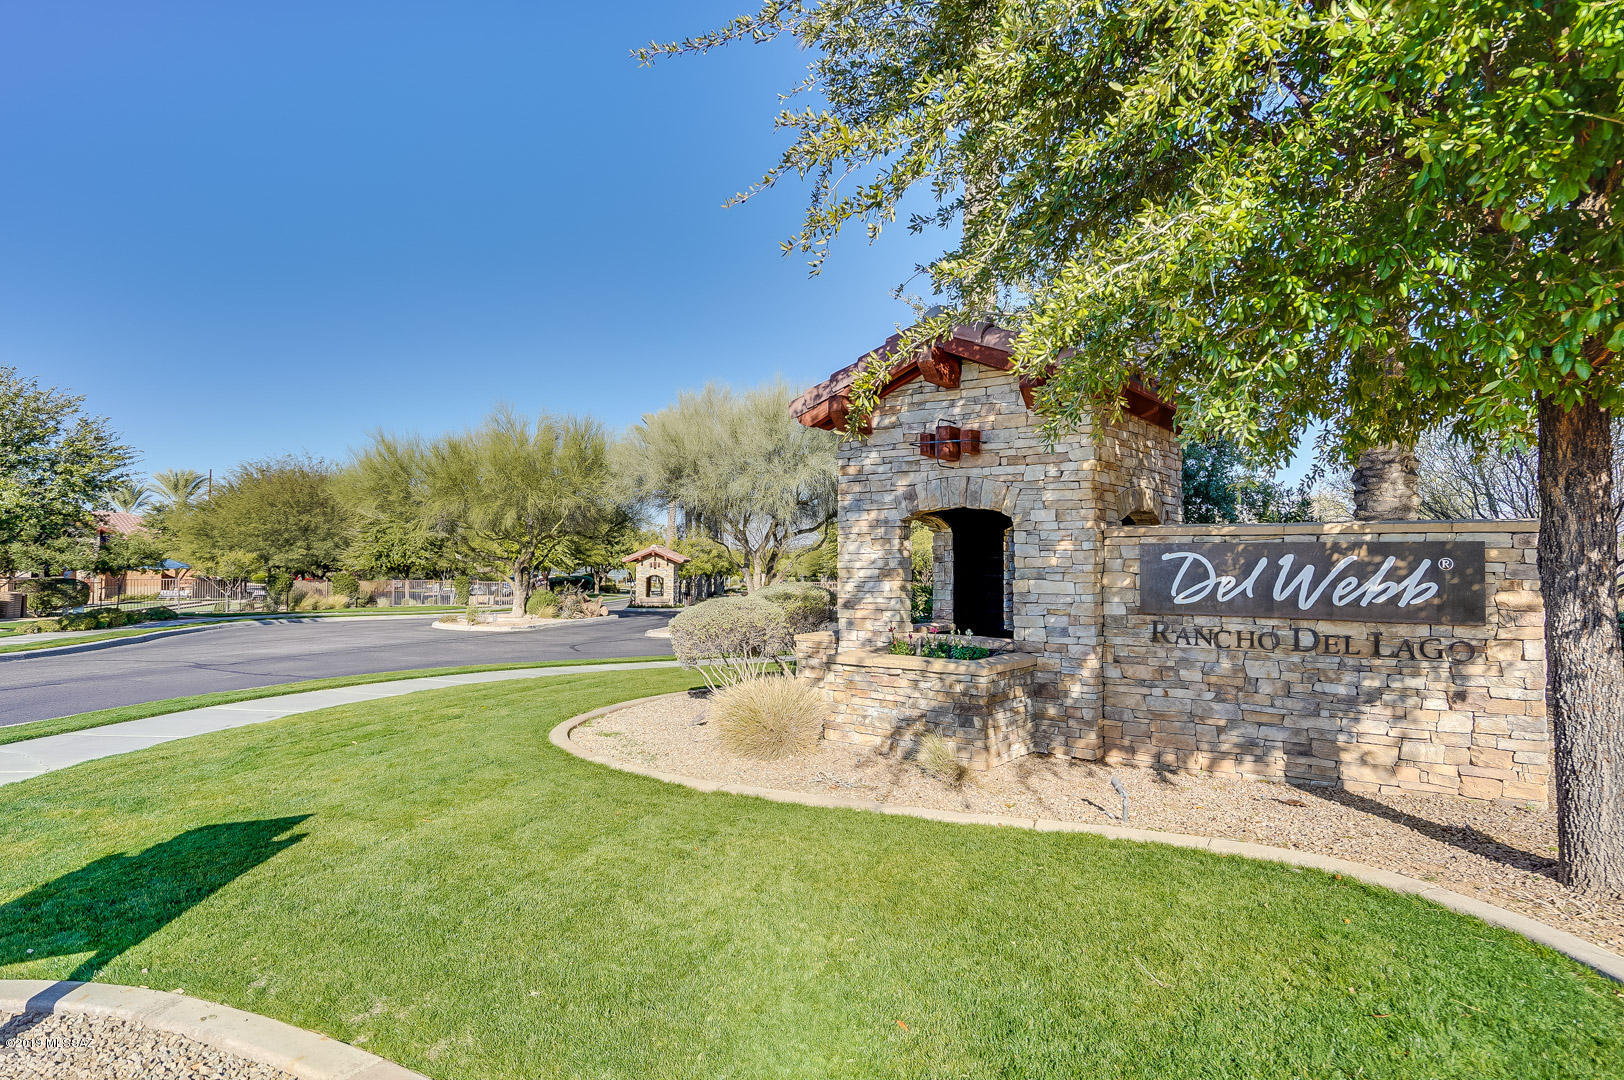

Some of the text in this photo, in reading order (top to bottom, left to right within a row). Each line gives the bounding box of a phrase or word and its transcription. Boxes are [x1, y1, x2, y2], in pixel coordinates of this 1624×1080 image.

[1161, 551, 1268, 605] Del
[1150, 620, 1476, 662] RANCHO DEL LAGO
